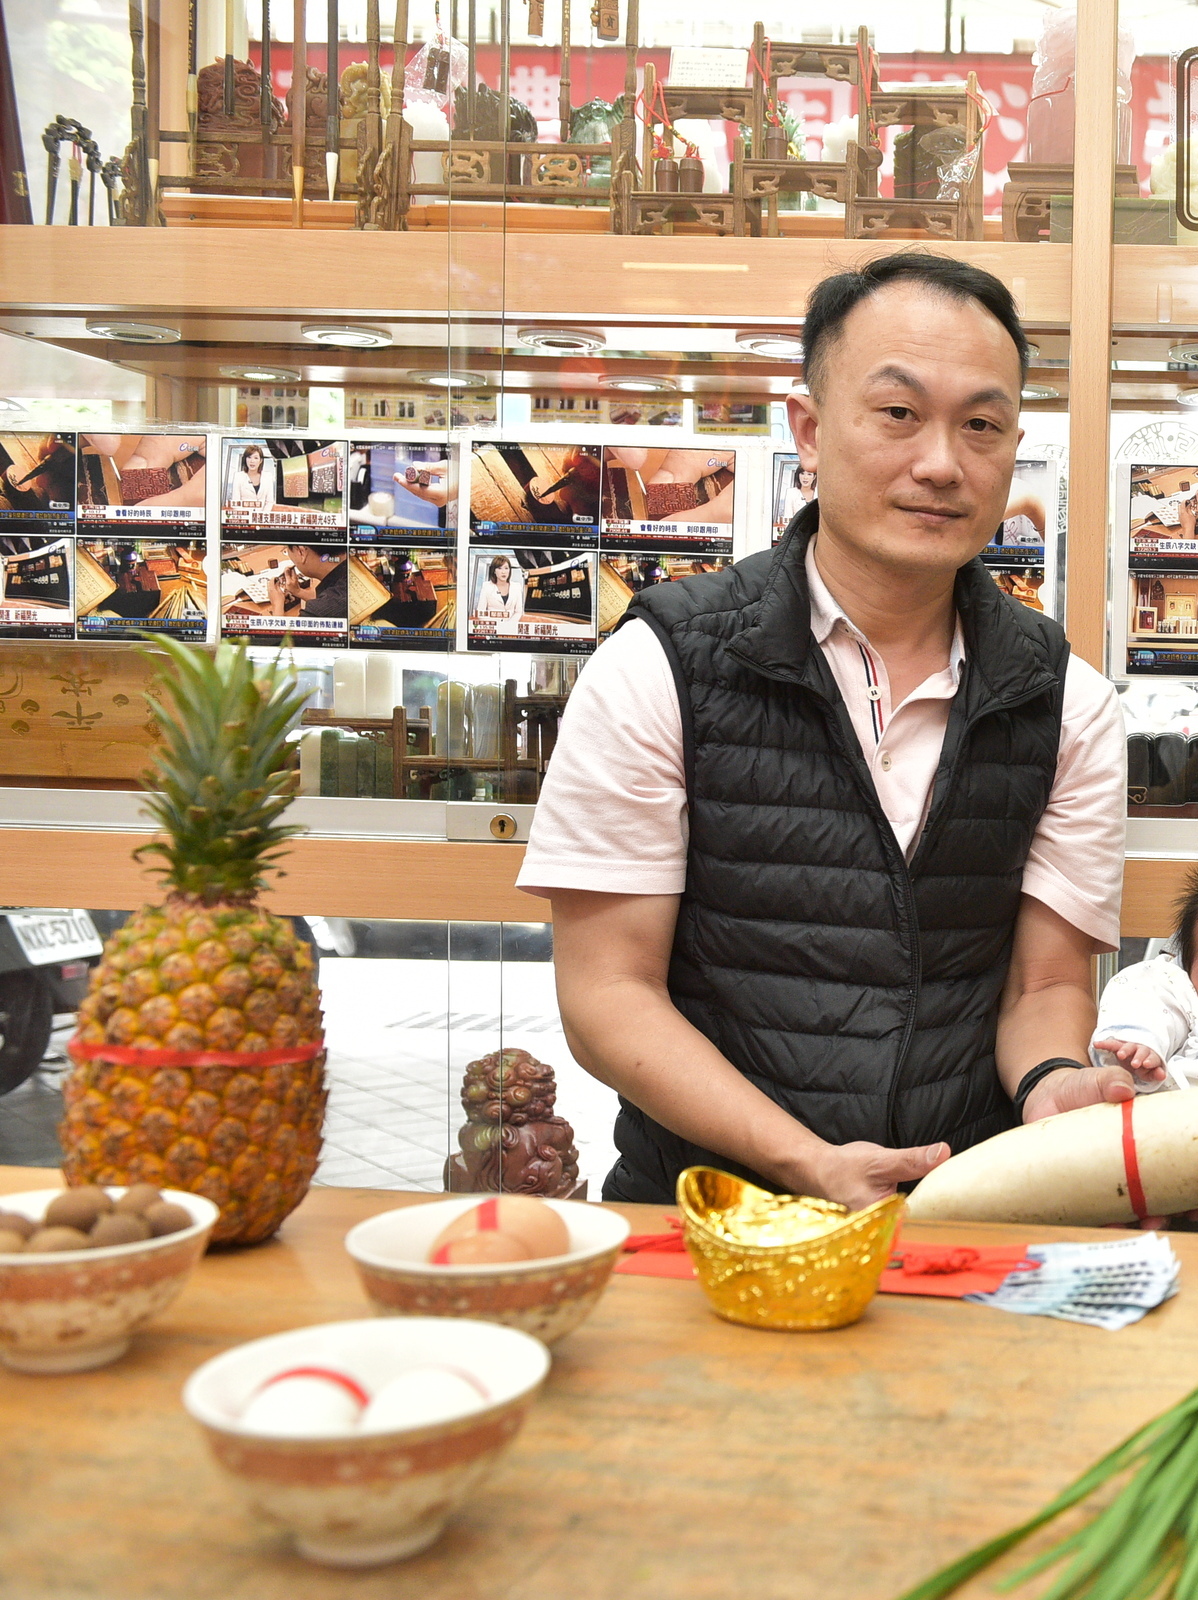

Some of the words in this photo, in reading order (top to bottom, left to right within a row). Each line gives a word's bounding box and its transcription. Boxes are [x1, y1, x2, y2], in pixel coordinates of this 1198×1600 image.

[1159, 541, 1197, 551] 生辰八字欠缺
[249, 618, 287, 627] 生辰八字欠缺
